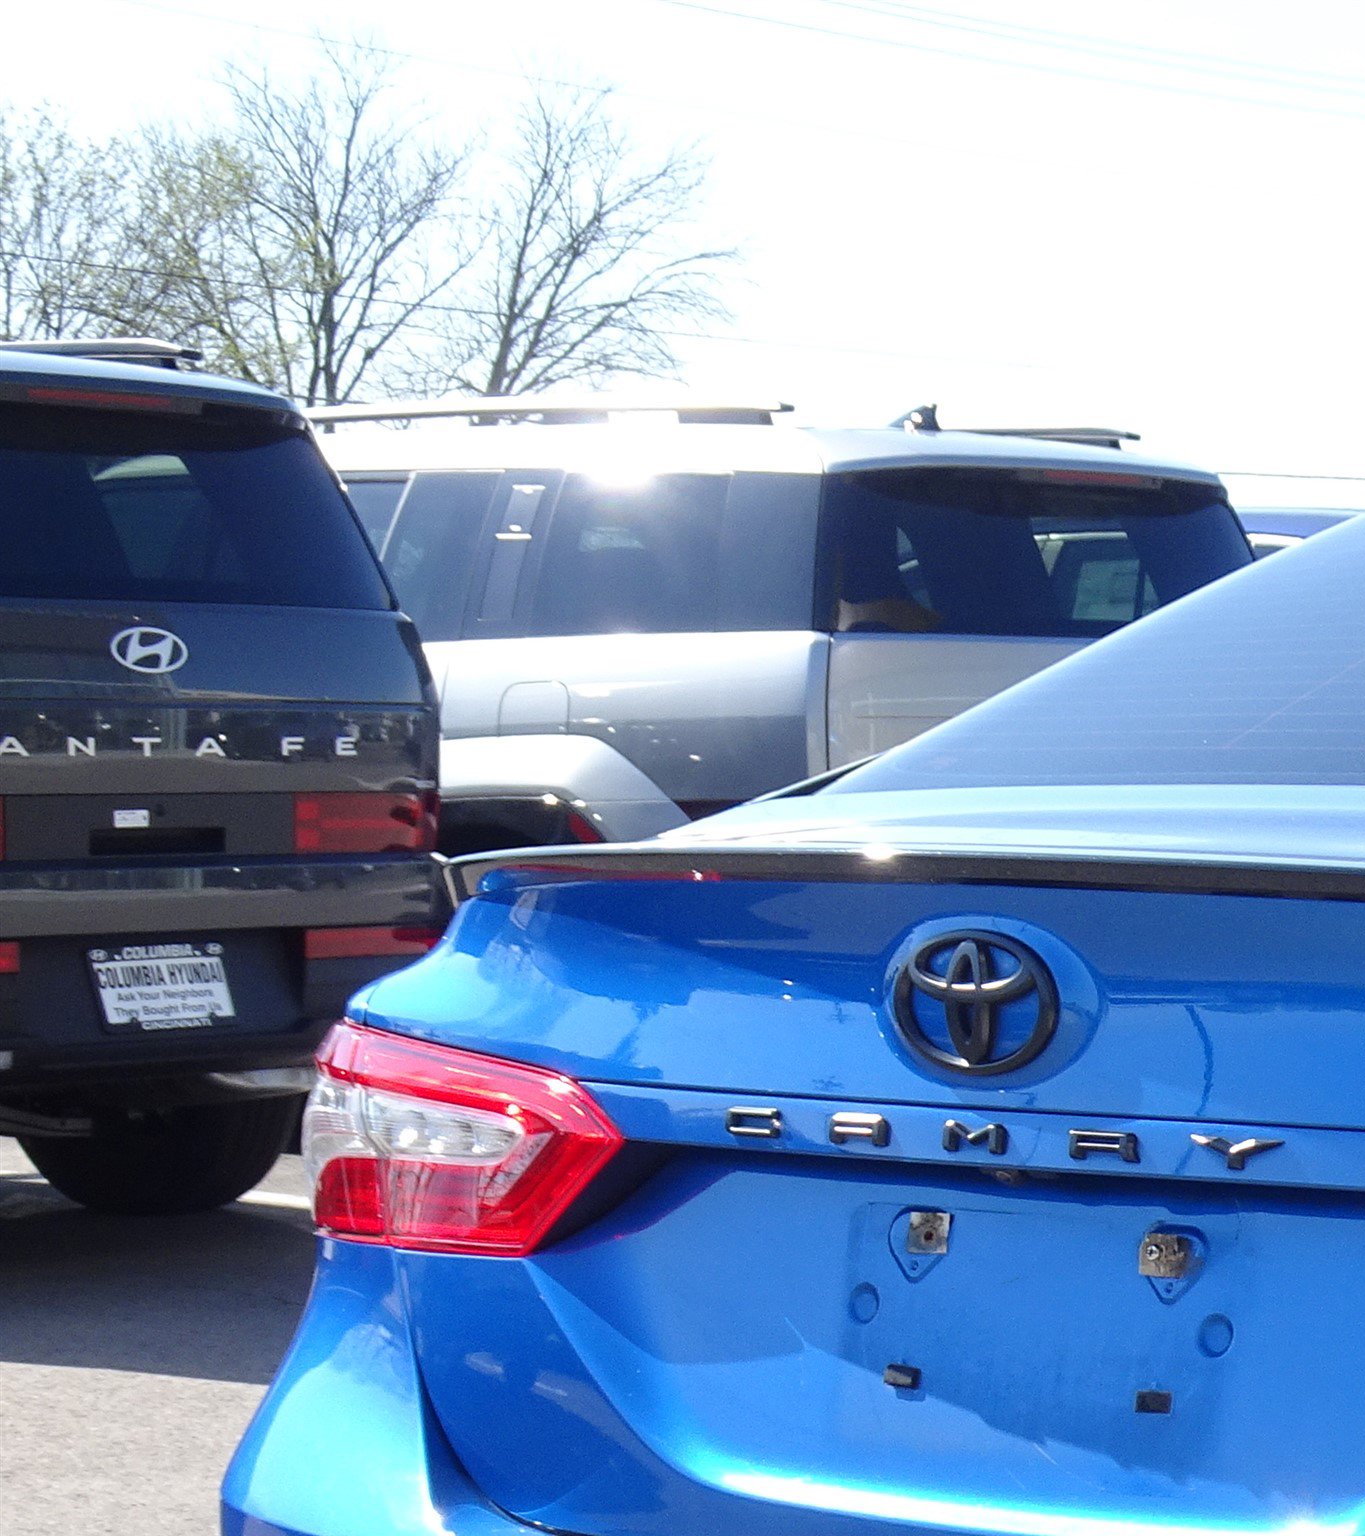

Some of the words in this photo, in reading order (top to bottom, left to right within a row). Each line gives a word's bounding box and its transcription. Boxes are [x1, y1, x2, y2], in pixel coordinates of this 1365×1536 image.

[0, 736, 226, 757] ANTA
[280, 736, 358, 757] FE
[122, 943, 193, 960] COLUMBIA
[97, 964, 166, 989] COLUMBIA
[167, 962, 224, 986] HYUNDAI
[117, 991, 135, 1002] Ask
[138, 990, 160, 1001] Your
[163, 988, 214, 1000] Neighbors
[113, 1006, 139, 1018] They
[142, 1004, 179, 1017] Bought
[182, 1003, 207, 1013] From
[141, 1018, 212, 1031] CINCINNATI
[725, 1105, 1286, 1171] CAMRY
